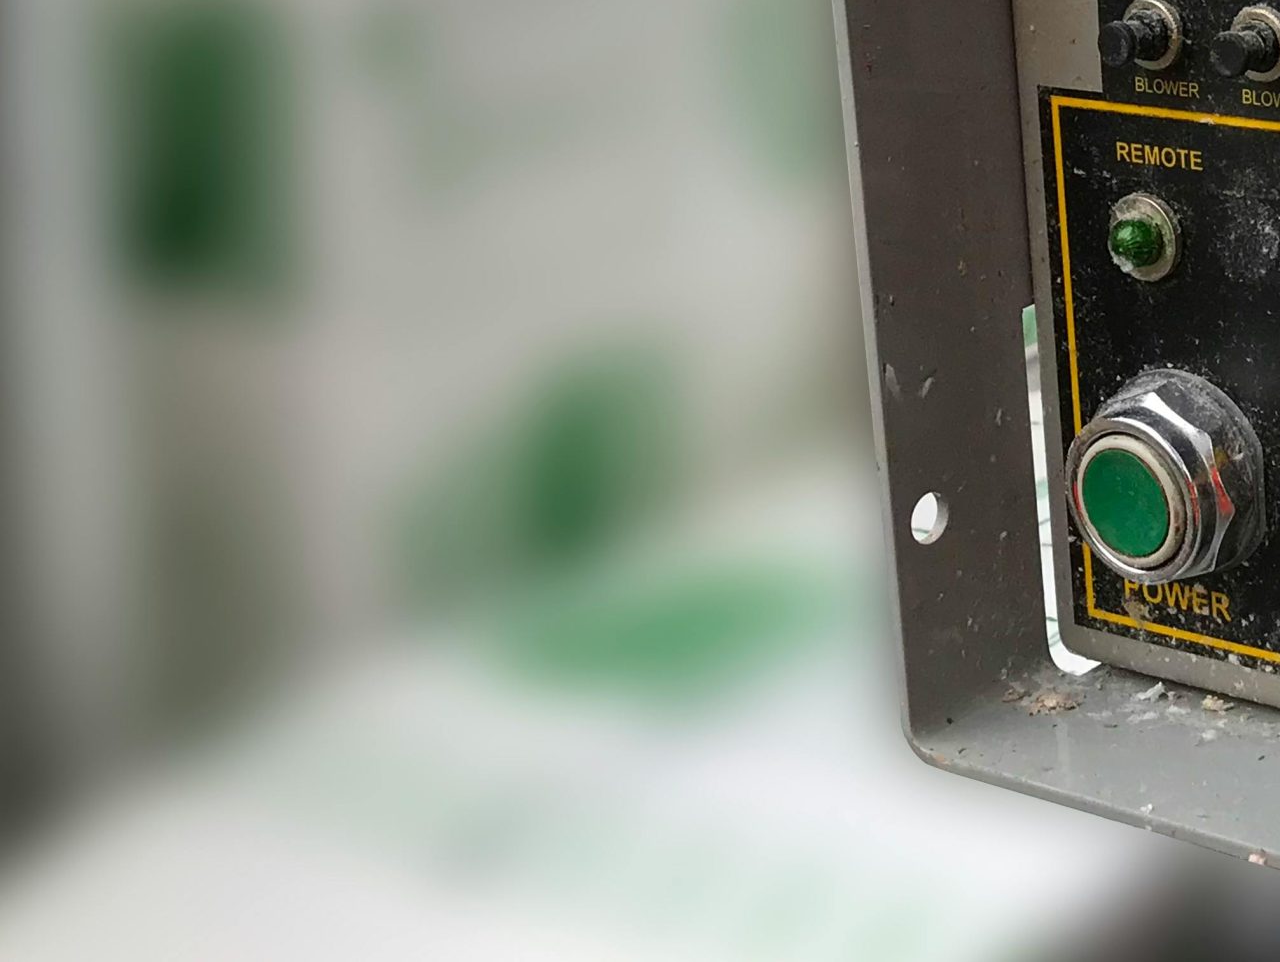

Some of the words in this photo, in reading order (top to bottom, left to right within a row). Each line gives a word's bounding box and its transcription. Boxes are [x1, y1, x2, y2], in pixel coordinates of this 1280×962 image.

[1135, 75, 1200, 99] BLOWER
[1115, 141, 1202, 171] REMOTE
[1124, 579, 1232, 622] POWER
